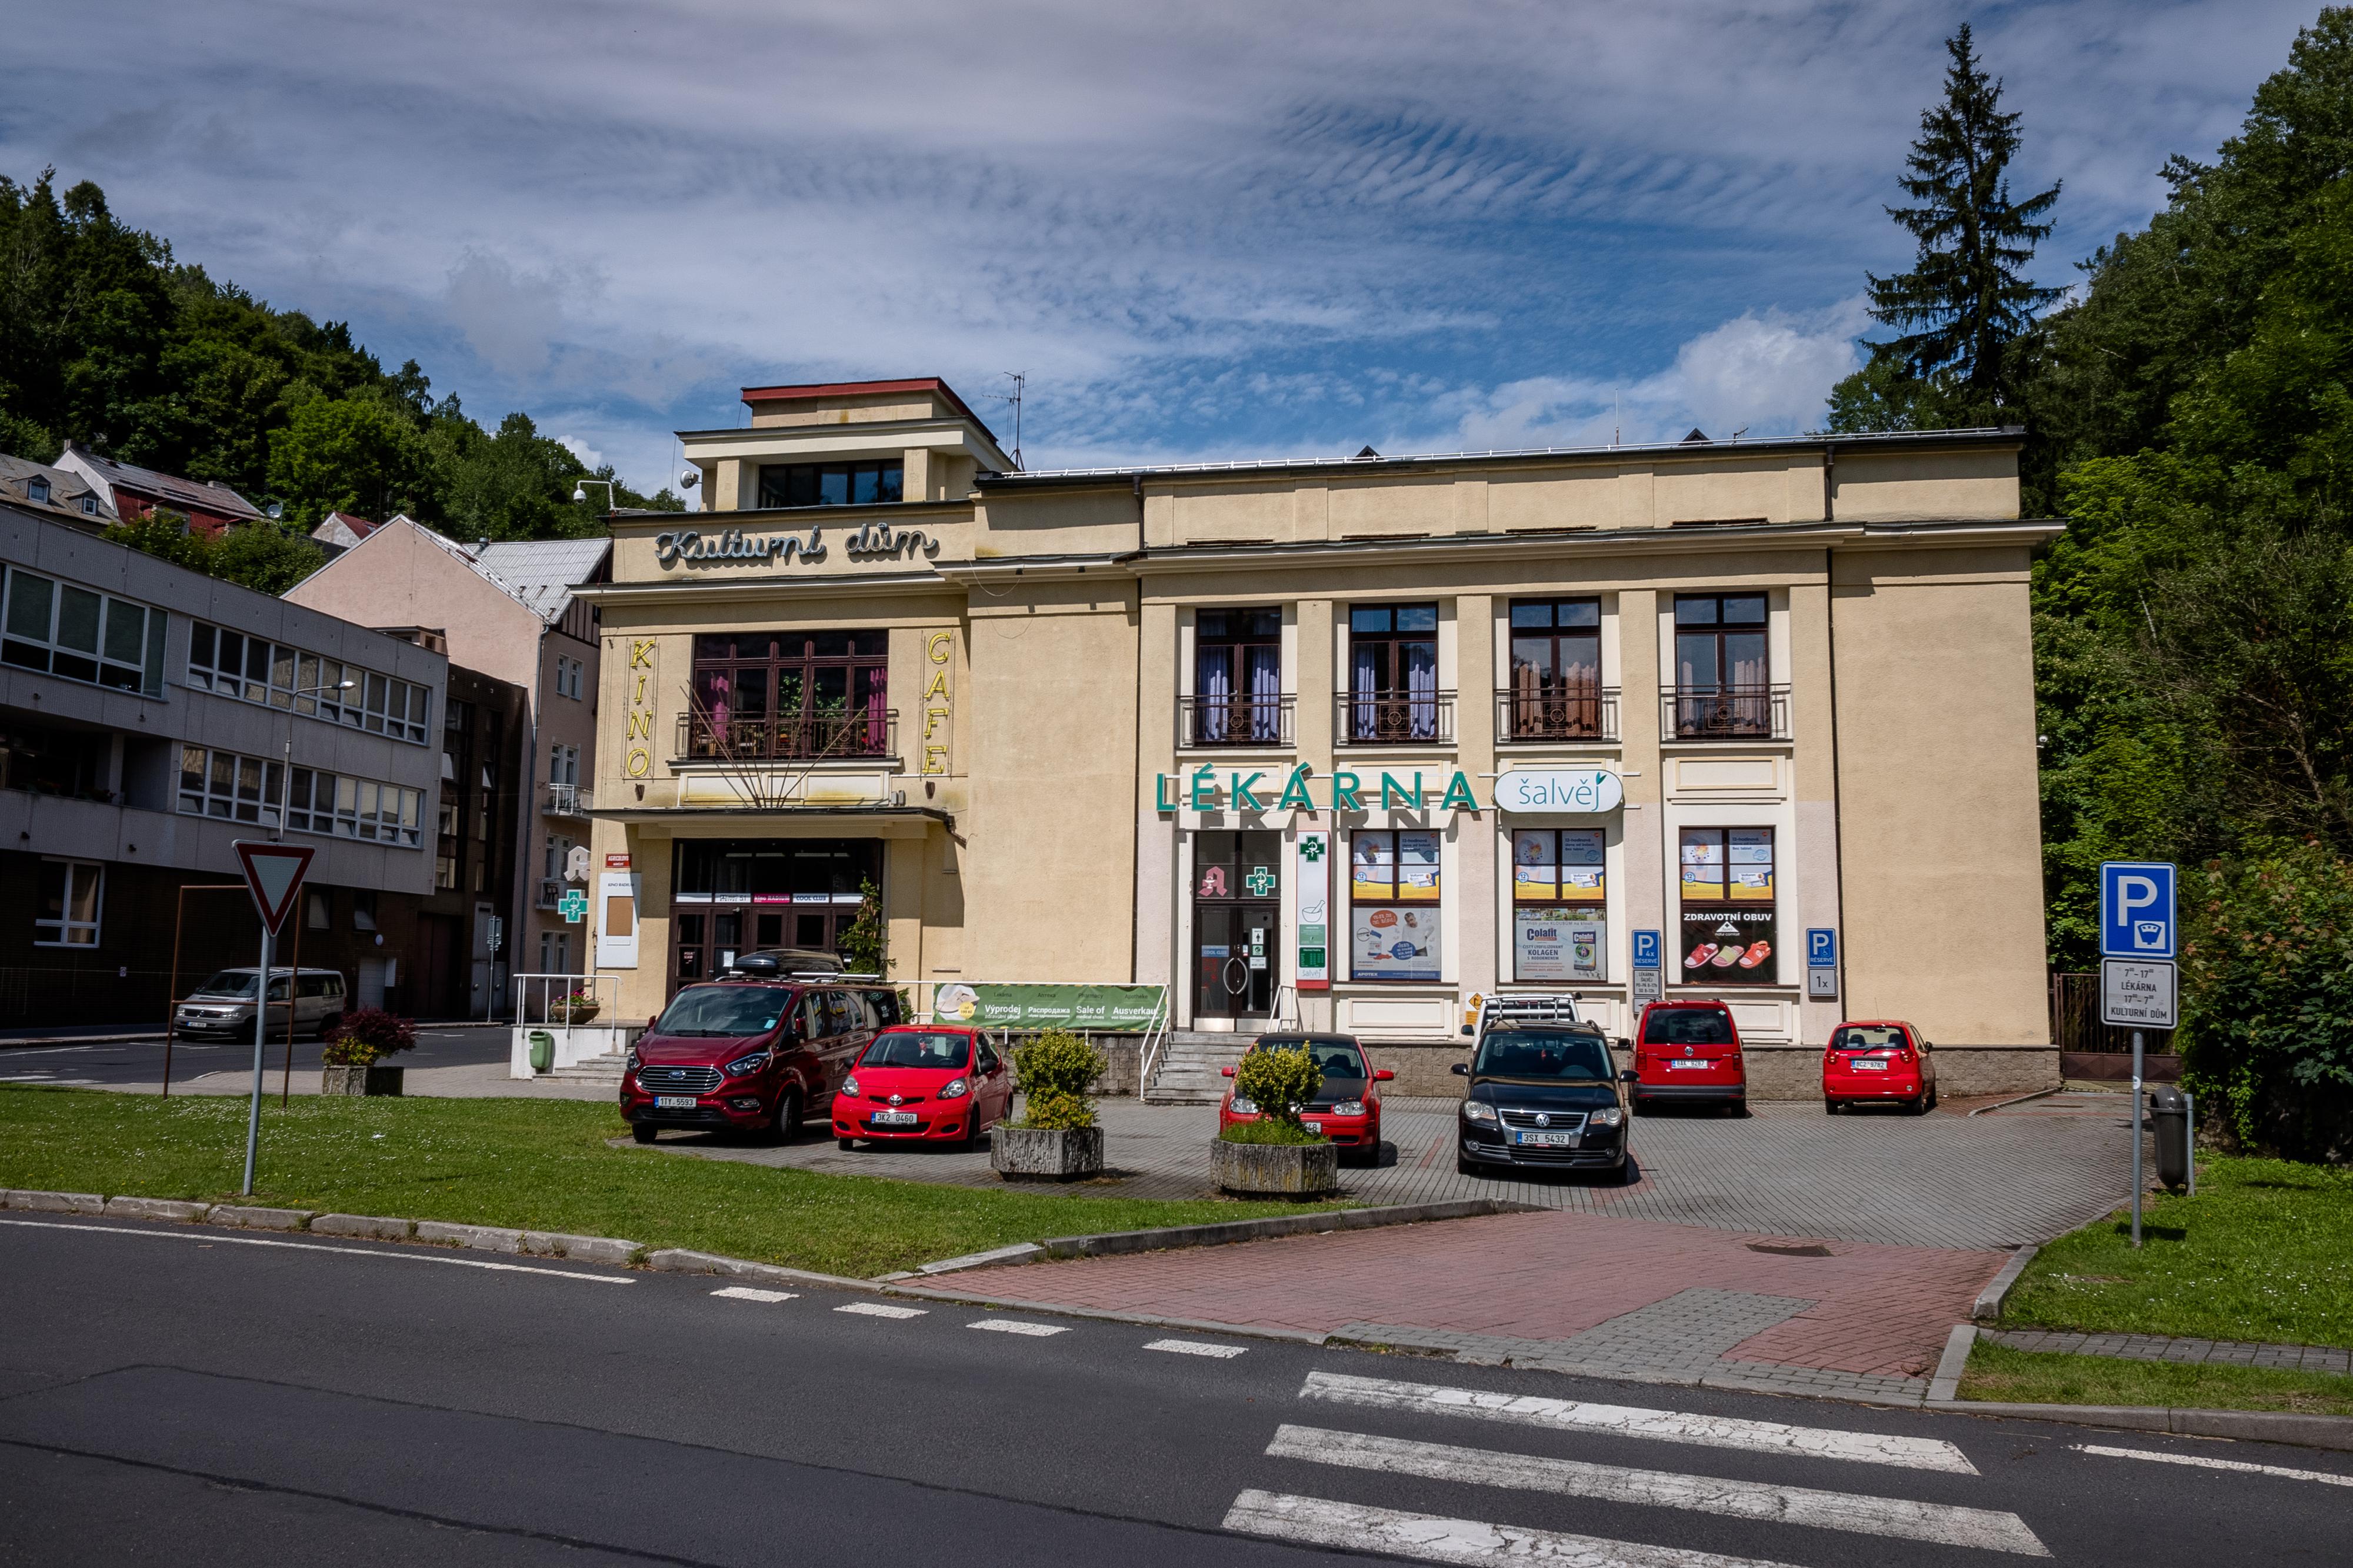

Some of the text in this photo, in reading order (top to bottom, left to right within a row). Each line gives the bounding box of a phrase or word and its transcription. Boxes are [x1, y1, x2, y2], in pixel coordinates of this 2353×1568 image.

[845, 522, 938, 554] dům
[627, 640, 655, 776] KINO
[922, 632, 951, 774] CAFE
[1156, 761, 1479, 812] LÉKÁRNA
[1518, 776, 1602, 812] šalvěj
[2118, 876, 2158, 926] P
[1684, 912, 1741, 920] ZDRAVOTNÍ
[1527, 928, 1558, 940] Colafit
[1574, 933, 1594, 942] Colafit
[1638, 935, 1654, 956] P
[1813, 933, 1829, 955] P
[1817, 976, 1828, 987] 1x
[2121, 980, 2157, 992] LÉKÁRNA
[985, 1005, 1021, 1014] Výprodej
[1076, 1005, 1105, 1014] Sale of
[1113, 1006, 1158, 1015] Ausverkau
[2111, 1007, 2167, 1019] KULTURNÍ DŮM
[1524, 1134, 1565, 1143] 3SX 5432
